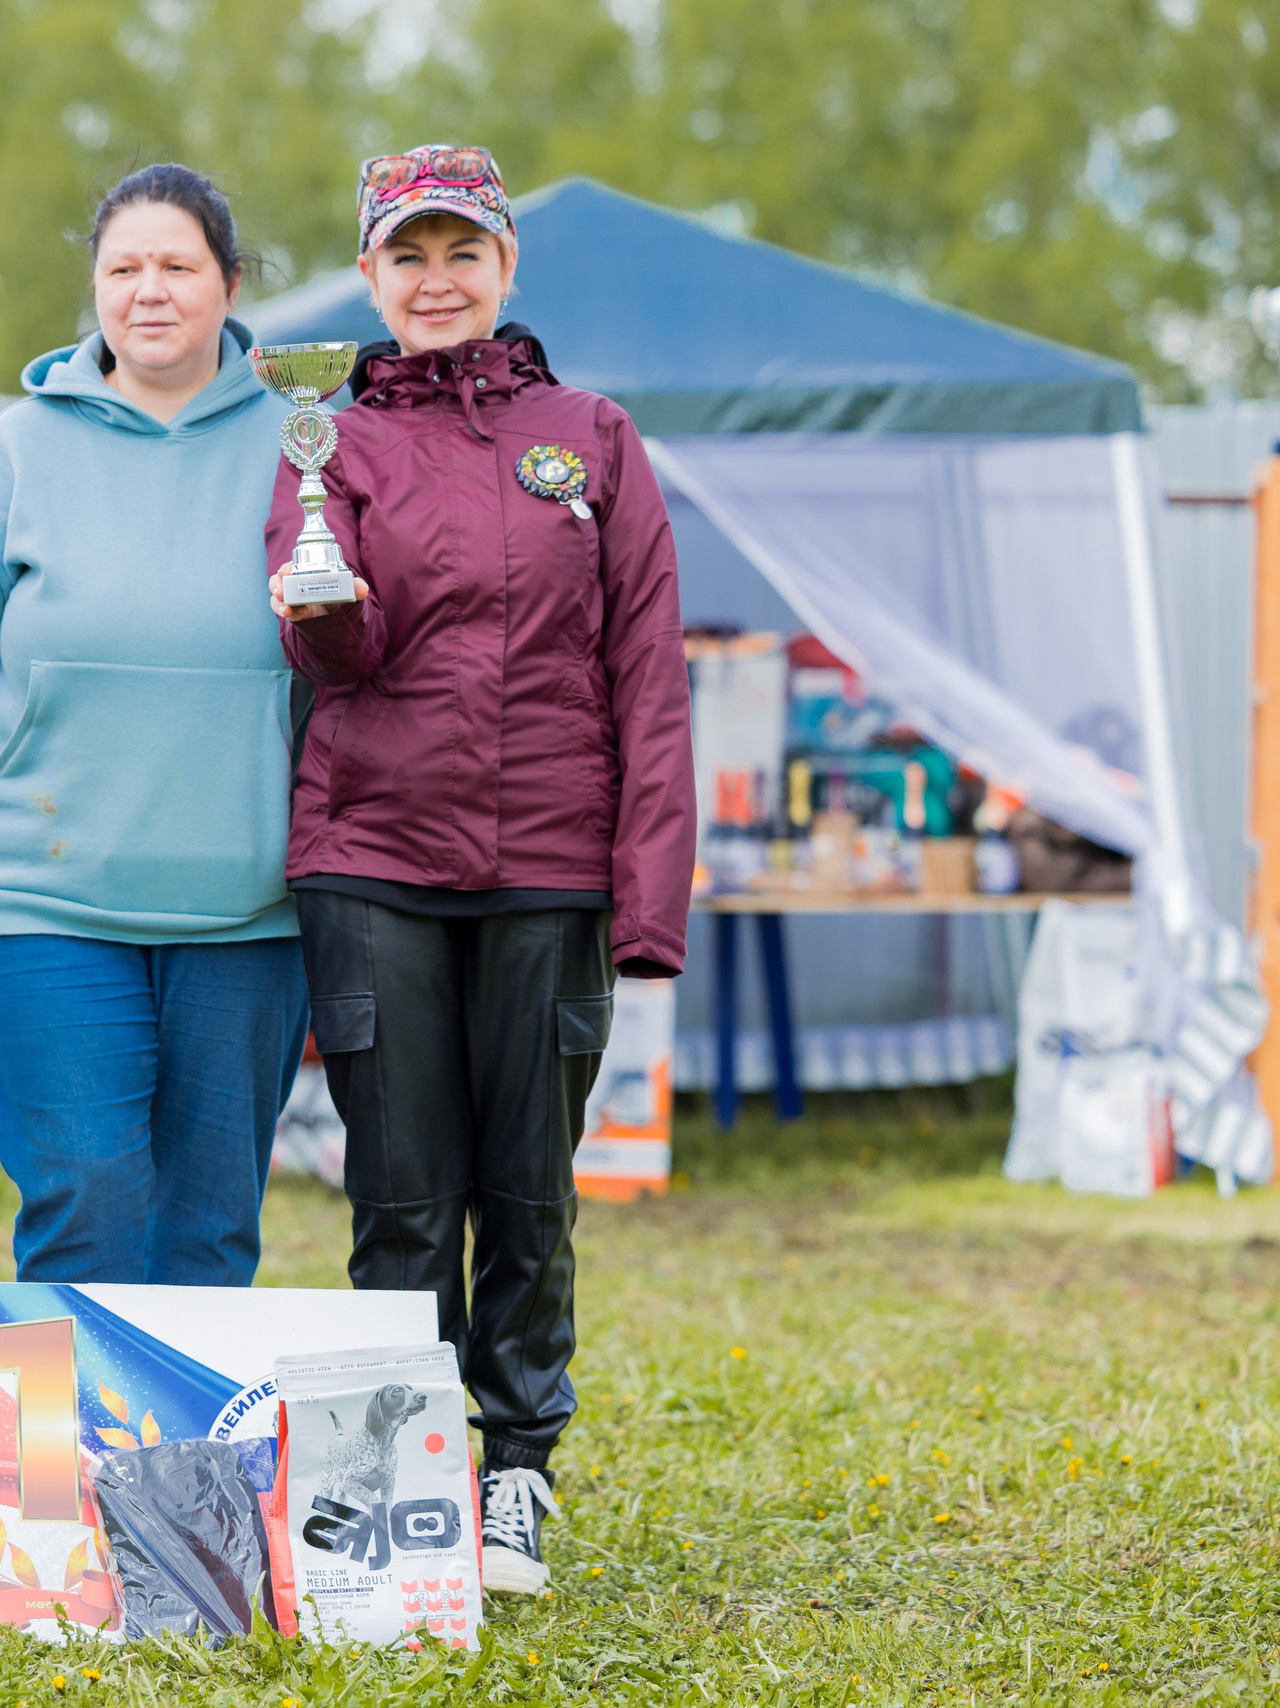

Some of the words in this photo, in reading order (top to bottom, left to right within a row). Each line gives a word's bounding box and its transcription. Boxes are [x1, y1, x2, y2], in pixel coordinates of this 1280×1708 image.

[215, 1378, 278, 1441] ВЕЙЛЕ
[307, 1577, 350, 1588] MEDIUM
[357, 1574, 393, 1586] ADULT
[25, 1600, 70, 1609] месо
